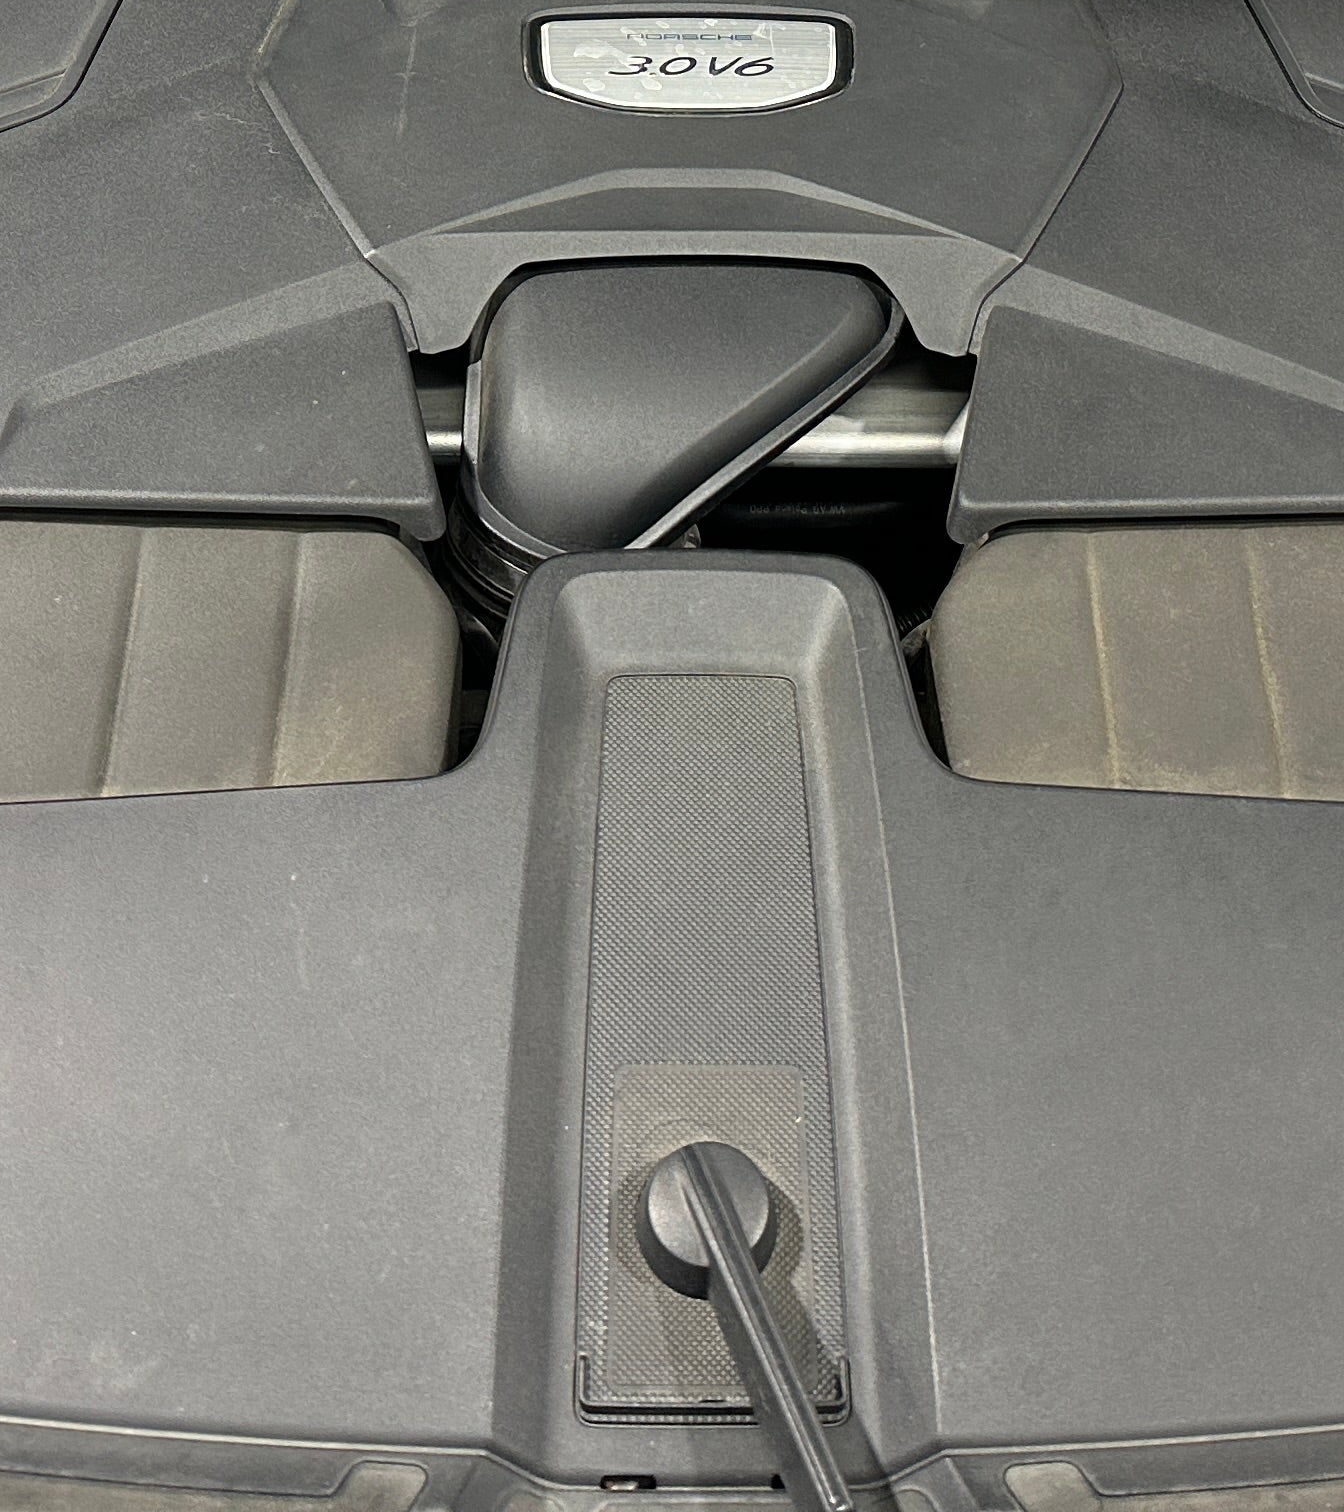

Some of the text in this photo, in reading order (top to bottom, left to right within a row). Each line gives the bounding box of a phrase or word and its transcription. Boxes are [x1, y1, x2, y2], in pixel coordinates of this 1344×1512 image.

[626, 33, 753, 41] PORSCHE
[608, 56, 775, 76] 3.0 V6
